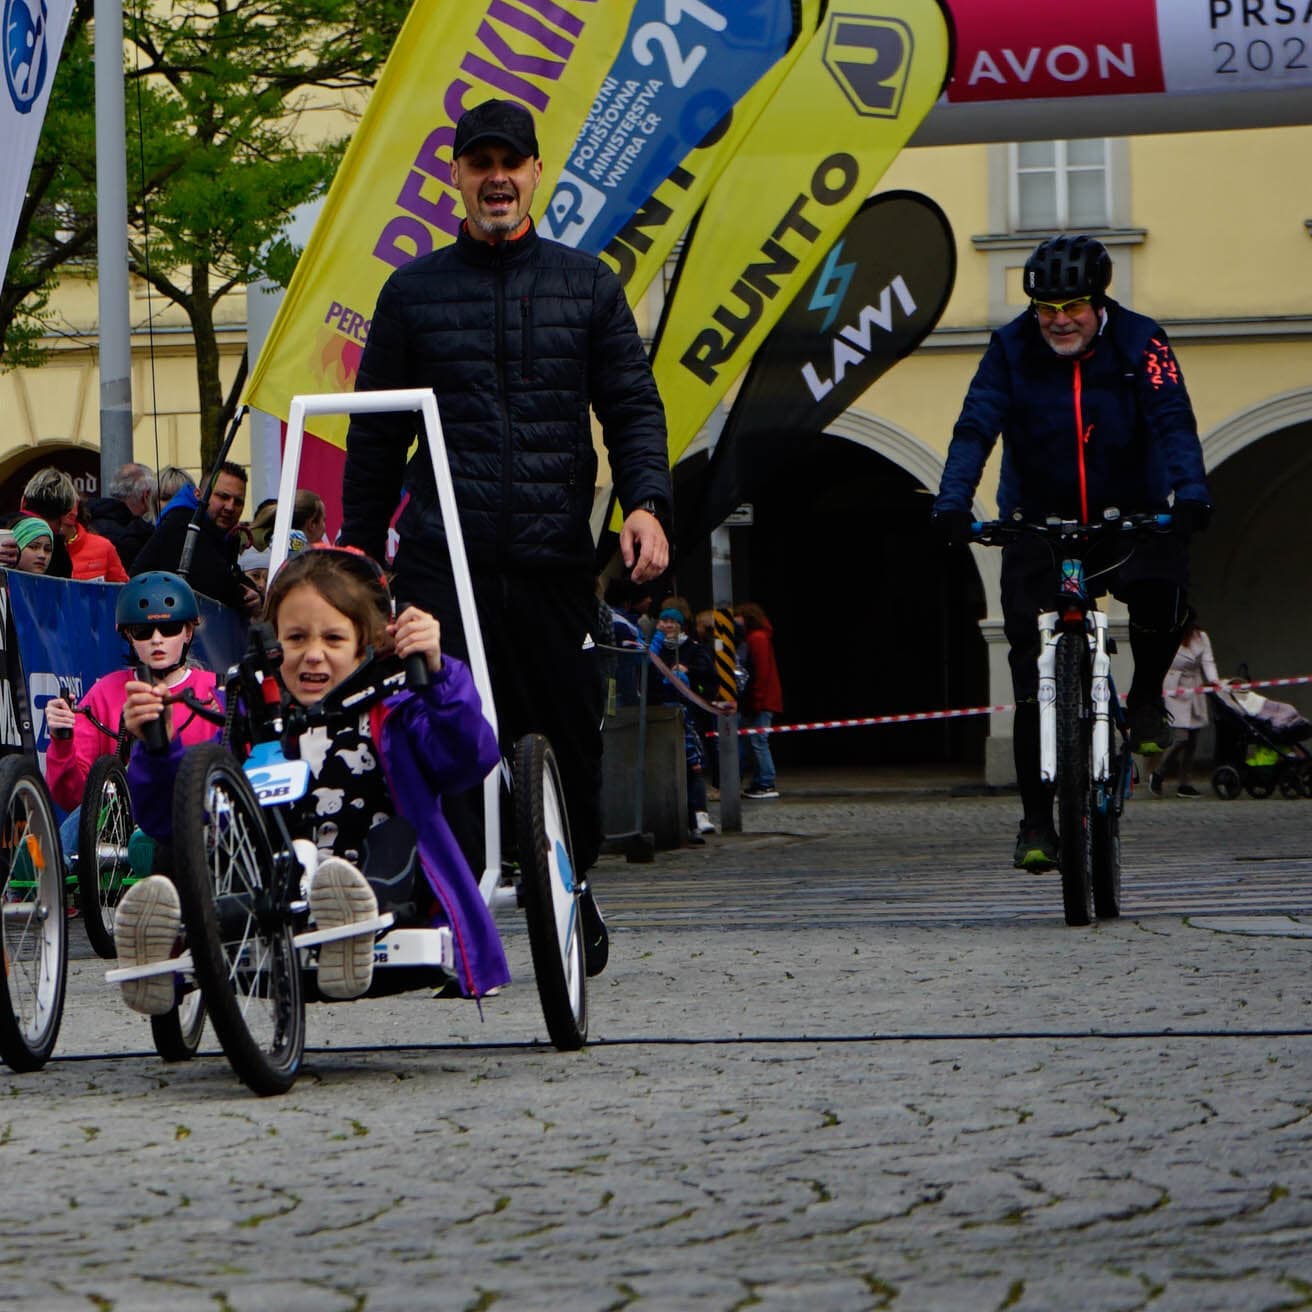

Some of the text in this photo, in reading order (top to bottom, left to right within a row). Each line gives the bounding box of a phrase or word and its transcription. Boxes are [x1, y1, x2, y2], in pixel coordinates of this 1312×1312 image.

[968, 43, 1136, 86] AVON
[1213, 37, 1309, 74] 202
[589, 79, 663, 181] MINISTERSTVA
[603, 112, 662, 188] VNITRA ČR
[680, 152, 859, 385] RUNTO
[801, 274, 917, 403] LAWI
